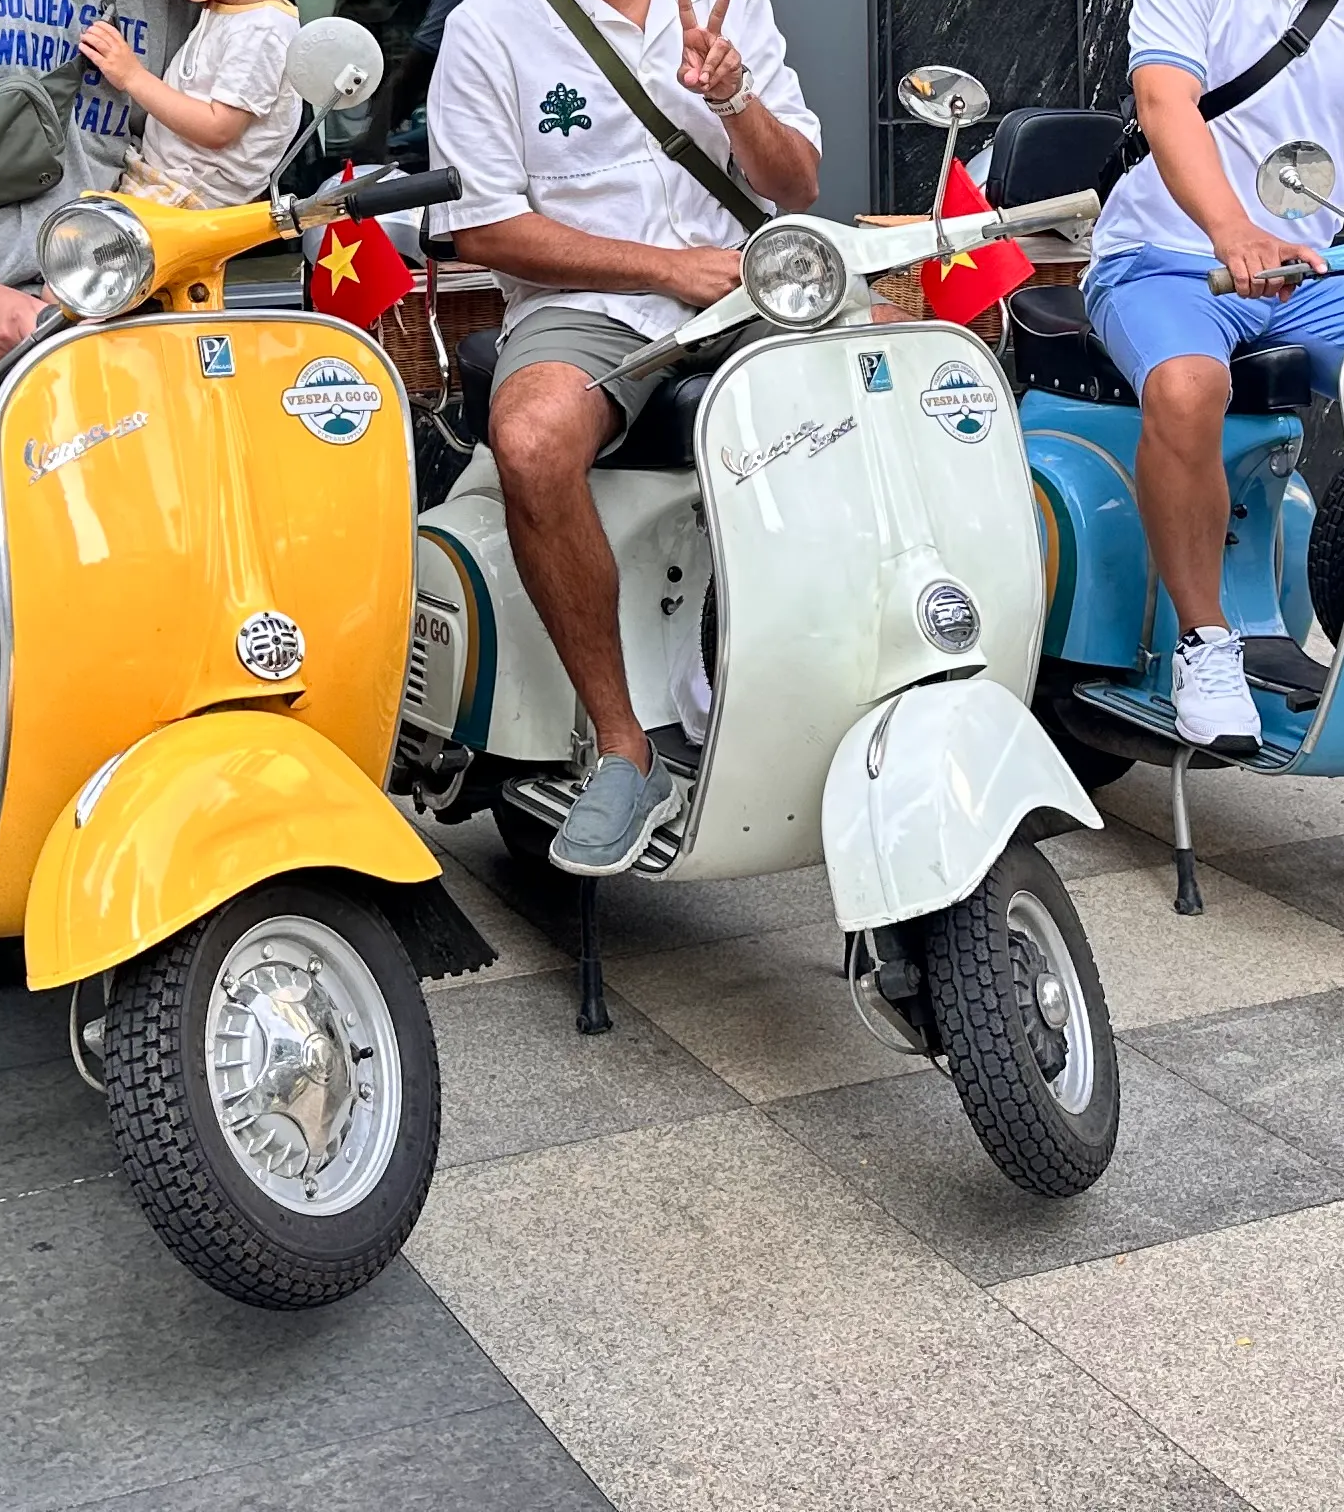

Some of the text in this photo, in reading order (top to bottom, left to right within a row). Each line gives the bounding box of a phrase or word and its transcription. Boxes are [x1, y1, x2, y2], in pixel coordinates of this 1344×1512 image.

[79, 5, 149, 55] STE
[286, 391, 378, 406] VESPA A GO GO
[924, 392, 994, 407] VESPA A GO GO
[430, 618, 450, 645] GO
